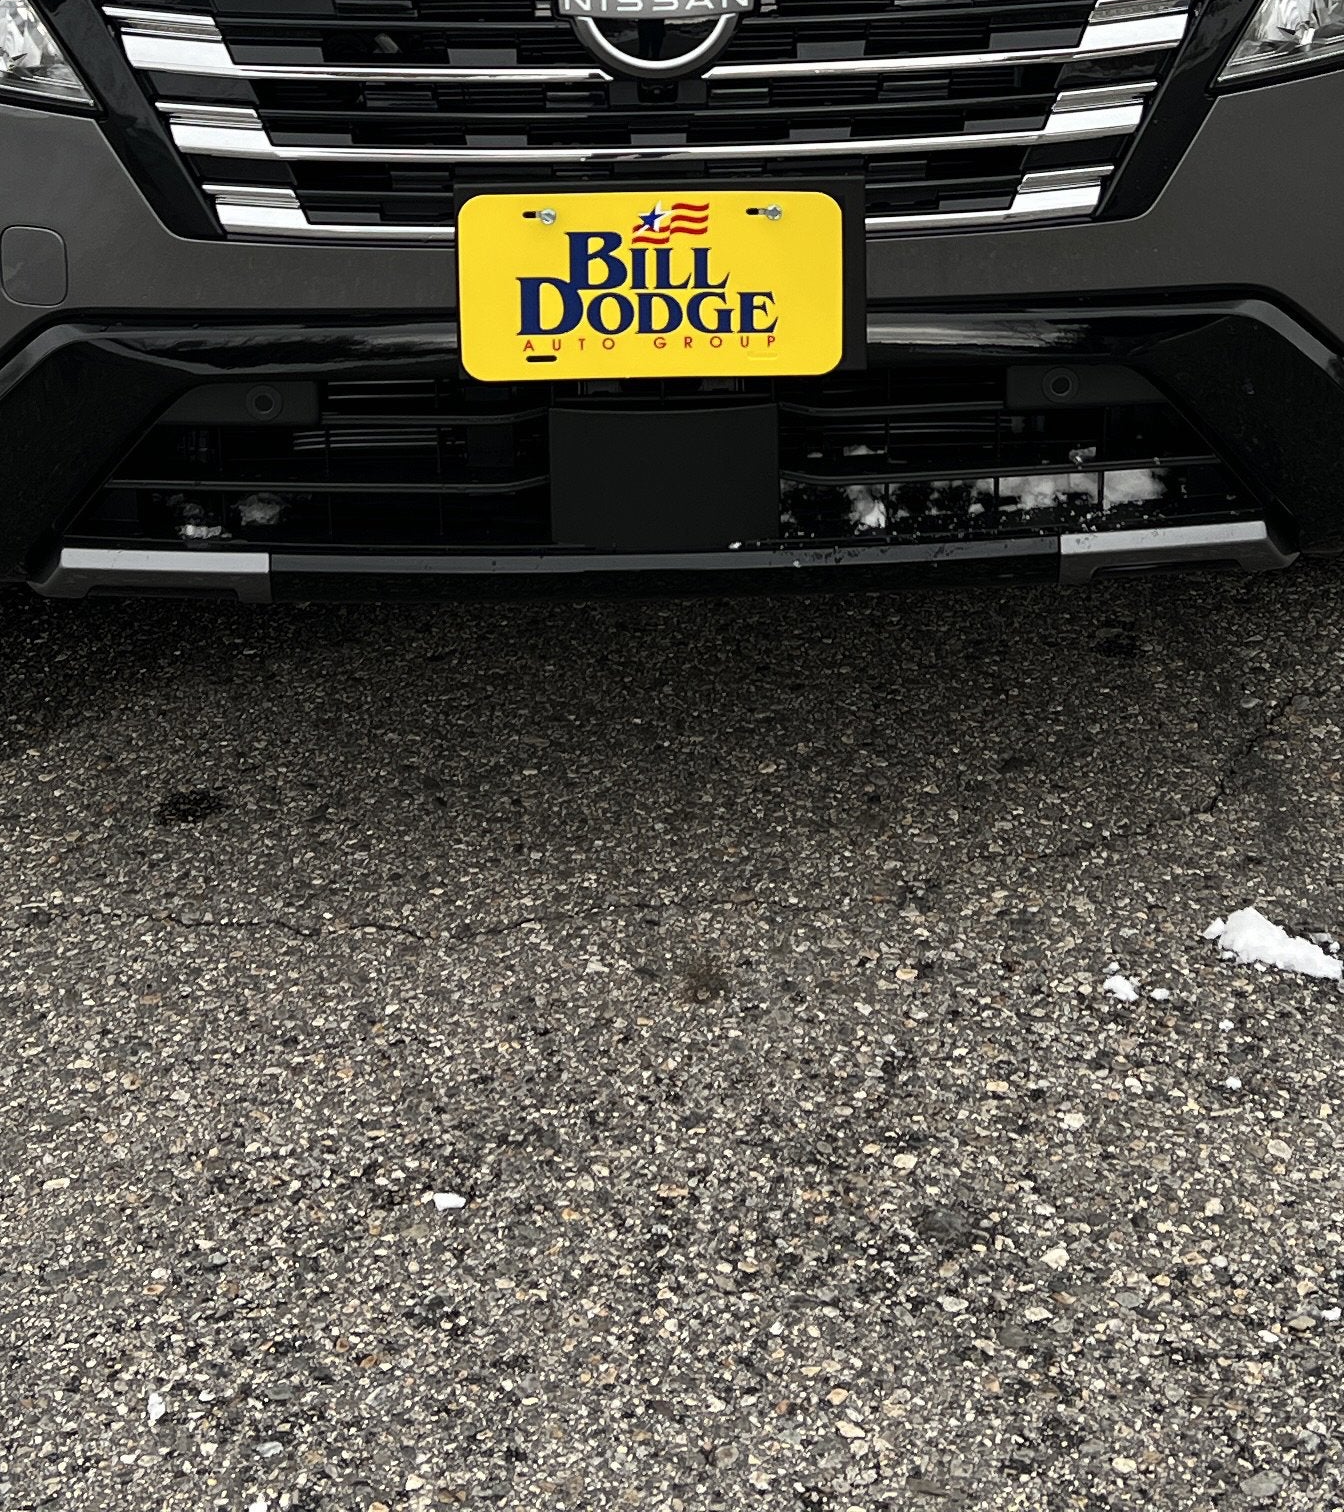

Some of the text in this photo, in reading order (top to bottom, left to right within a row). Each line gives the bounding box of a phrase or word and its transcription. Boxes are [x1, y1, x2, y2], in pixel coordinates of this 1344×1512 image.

[564, 231, 730, 290] BILL
[516, 276, 779, 336] DODGE
[522, 334, 777, 352] AUTO GROUP
